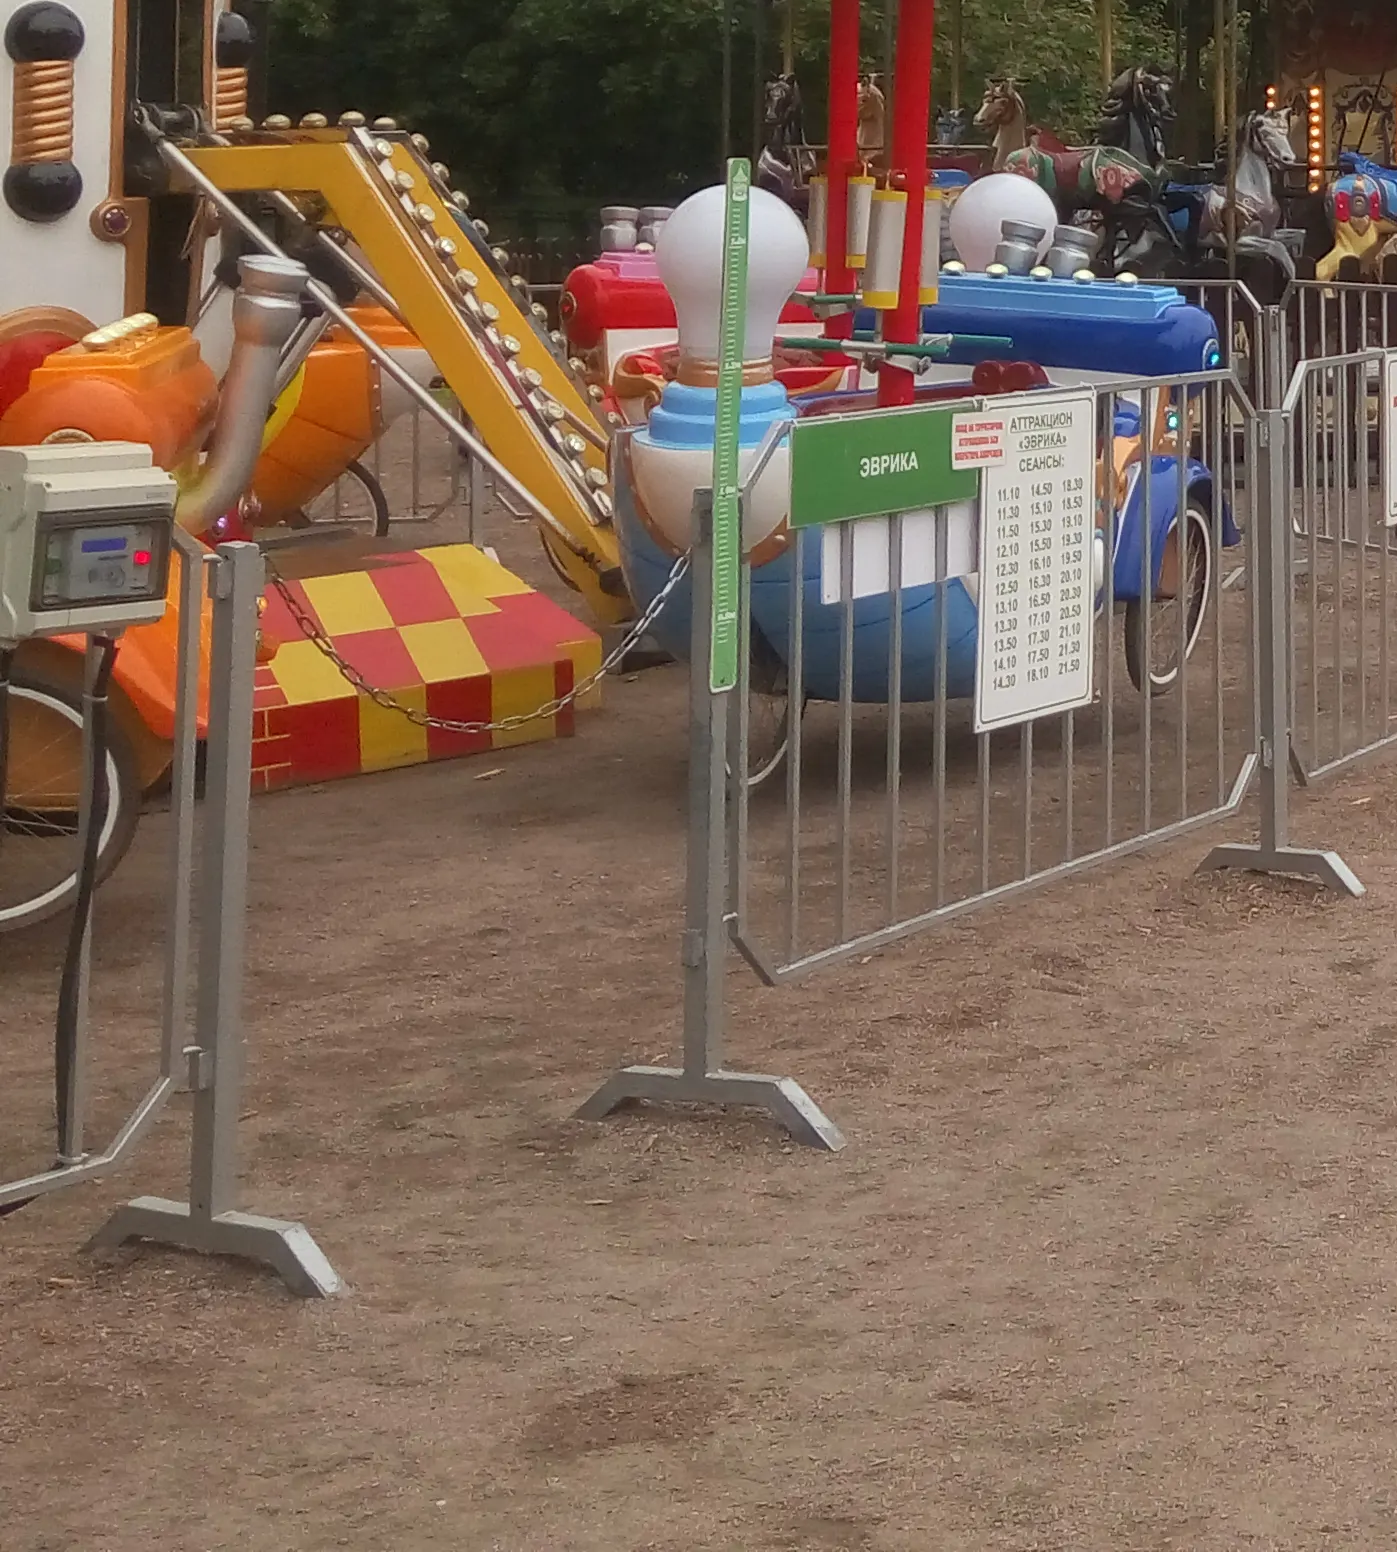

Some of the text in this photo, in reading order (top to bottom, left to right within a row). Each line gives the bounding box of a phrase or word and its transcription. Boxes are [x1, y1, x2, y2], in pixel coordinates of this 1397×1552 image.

[1010, 412, 1073, 430] АТТРАКЦИОН
[1019, 432, 1067, 450] «ЭВРИКА»
[860, 451, 918, 478] ЭВРИКА
[1019, 454, 1065, 472] СЕАНСЫ:
[998, 477, 1083, 501] 11.10 14.50 18.30
[997, 495, 1083, 521] 11.30 15.10 18.50
[997, 513, 1083, 539] 11.50 15.30 19.10
[996, 532, 1082, 558] 12.10 15.50 19.30
[996, 549, 1082, 577] 12.30 16.10 19.50
[995, 567, 1082, 596] 12.50 16.30 20.10
[995, 586, 1081, 614] 13.10 16.50 20.30
[994, 604, 1081, 634] 13.30 17.10 20.50
[994, 622, 1081, 653] 13.50 17.30 21.10
[993, 640, 1080, 672] 14.10 17.50 21.30
[993, 658, 1080, 690] 14.30 18.10 21.50
